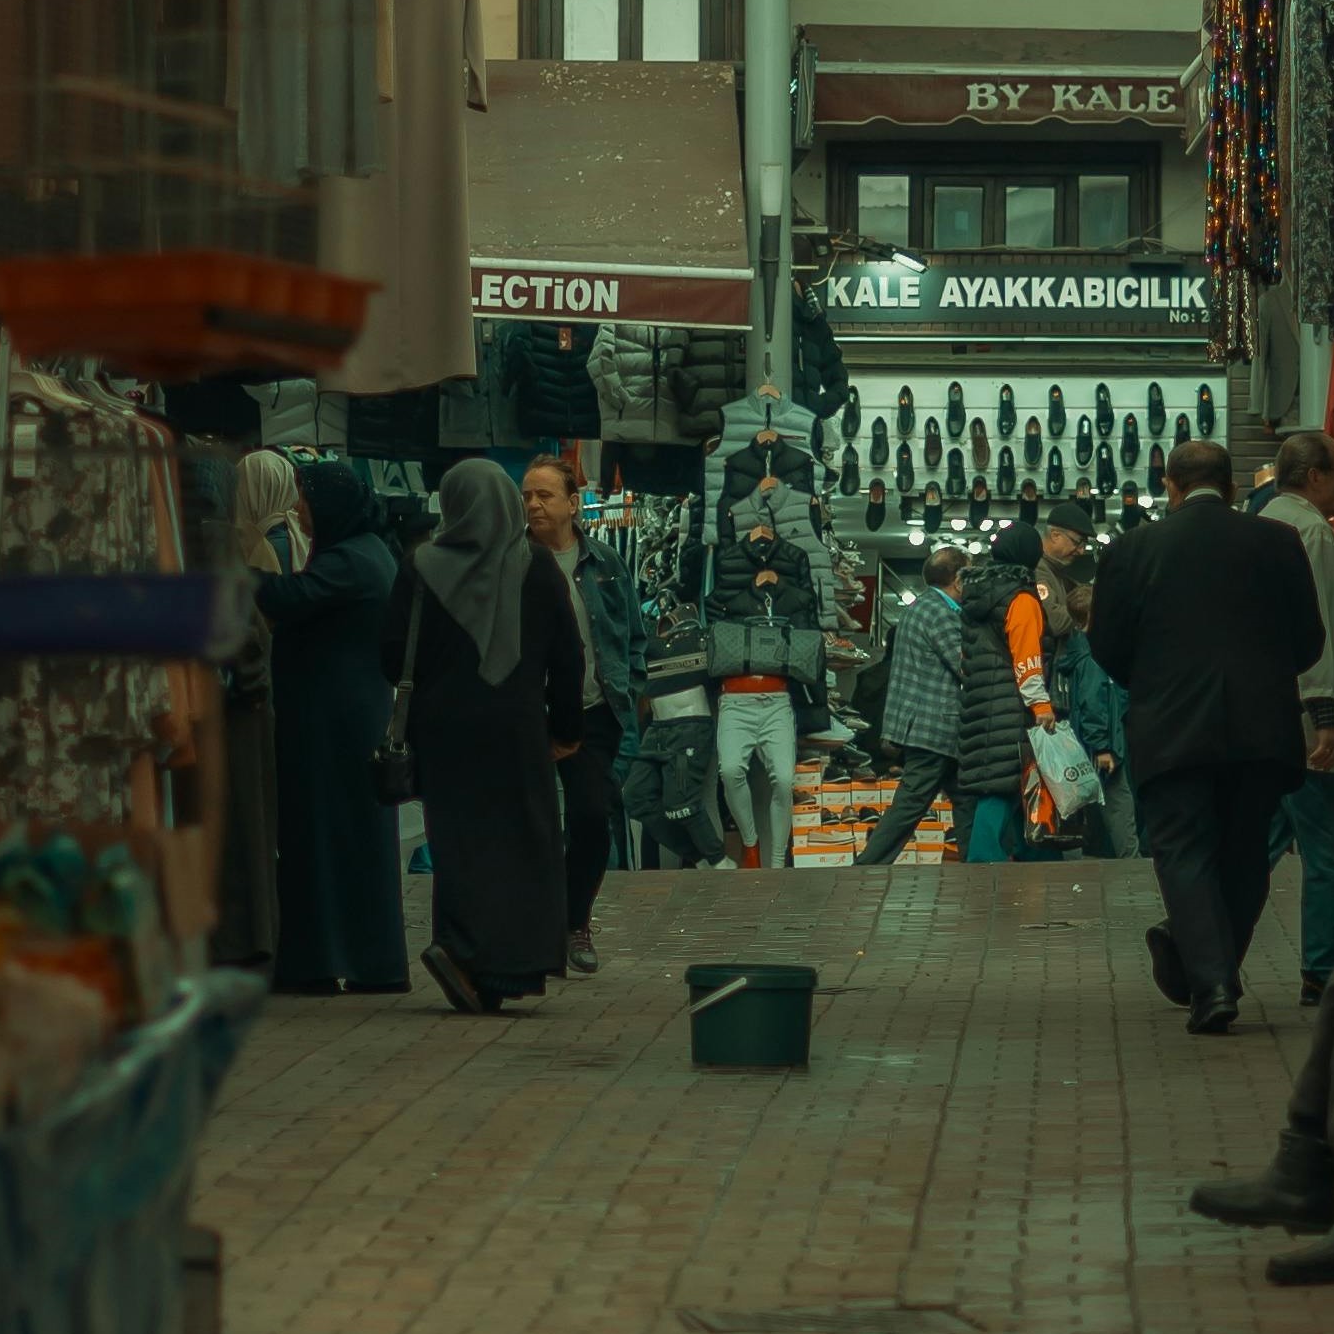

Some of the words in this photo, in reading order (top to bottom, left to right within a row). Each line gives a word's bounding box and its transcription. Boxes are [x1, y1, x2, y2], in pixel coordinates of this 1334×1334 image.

[966, 82, 1030, 112] BY
[1051, 84, 1178, 114] KALE
[827, 276, 920, 308] KALE
[939, 276, 1207, 309] AYAKKABICILIK
